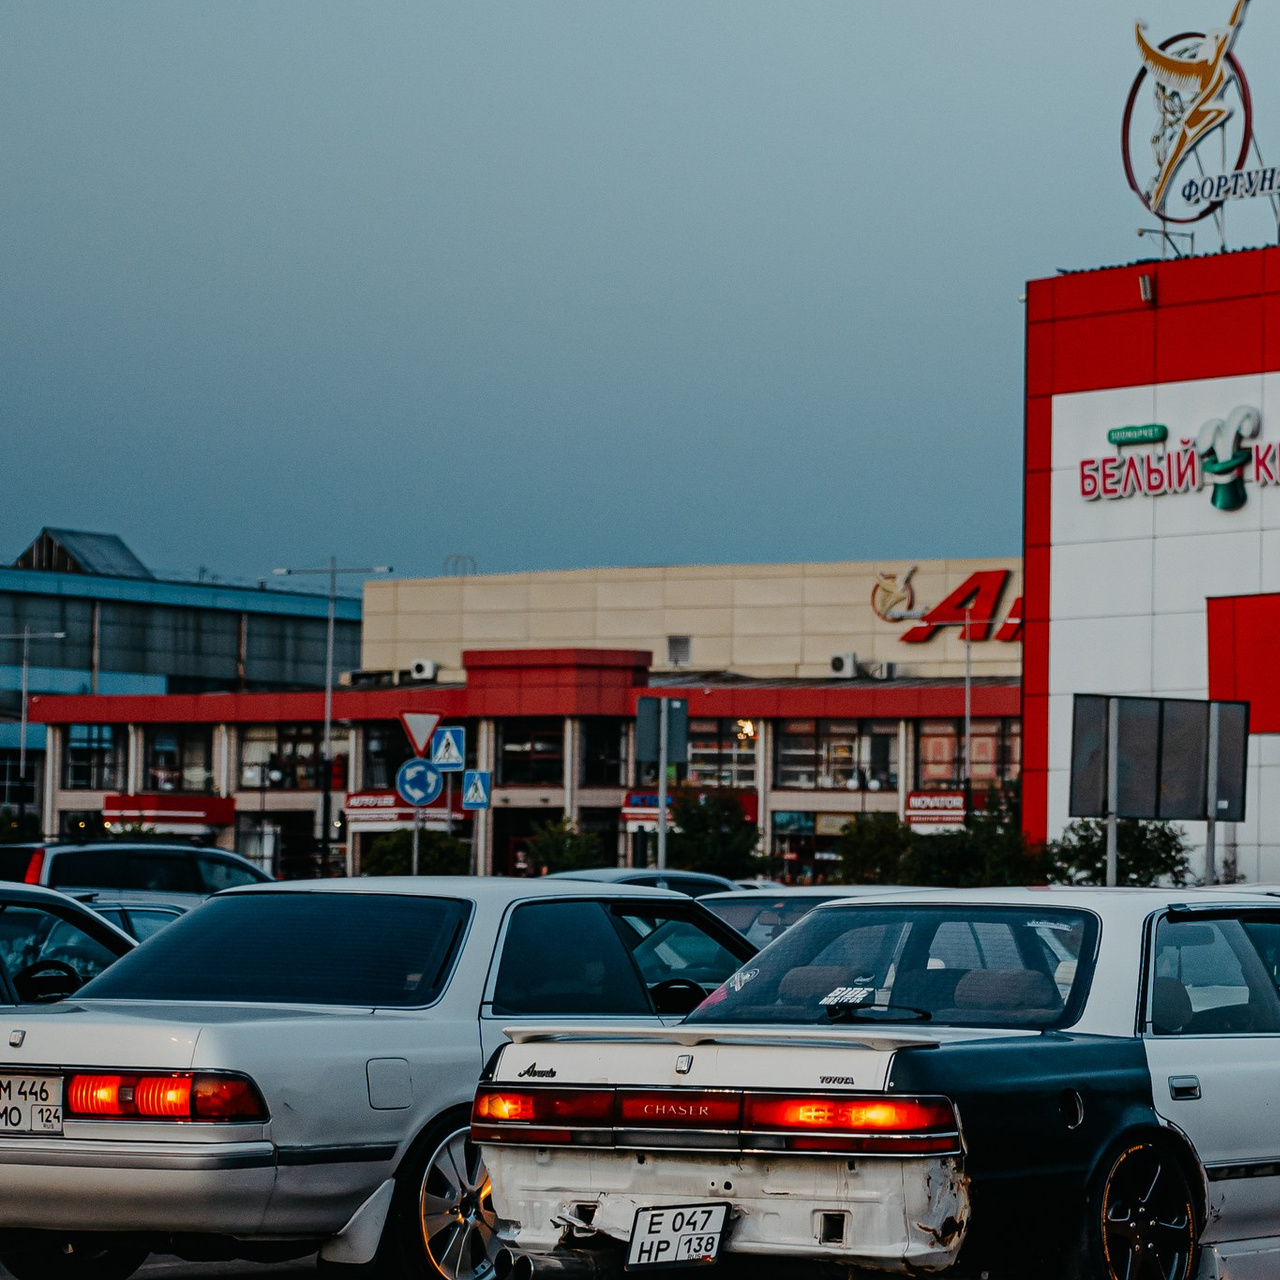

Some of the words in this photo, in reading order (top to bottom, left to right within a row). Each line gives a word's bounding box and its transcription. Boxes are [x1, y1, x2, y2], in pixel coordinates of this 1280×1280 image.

[1079, 438, 1198, 498] БЕЛЫЙ
[819, 1076, 855, 1085] TOYOTA
[17, 1080, 49, 1102] 446
[38, 1108, 61, 1123] 124
[643, 1104, 710, 1116] CHASER
[672, 1210, 714, 1232] 047
[684, 1237, 715, 1254] 138
